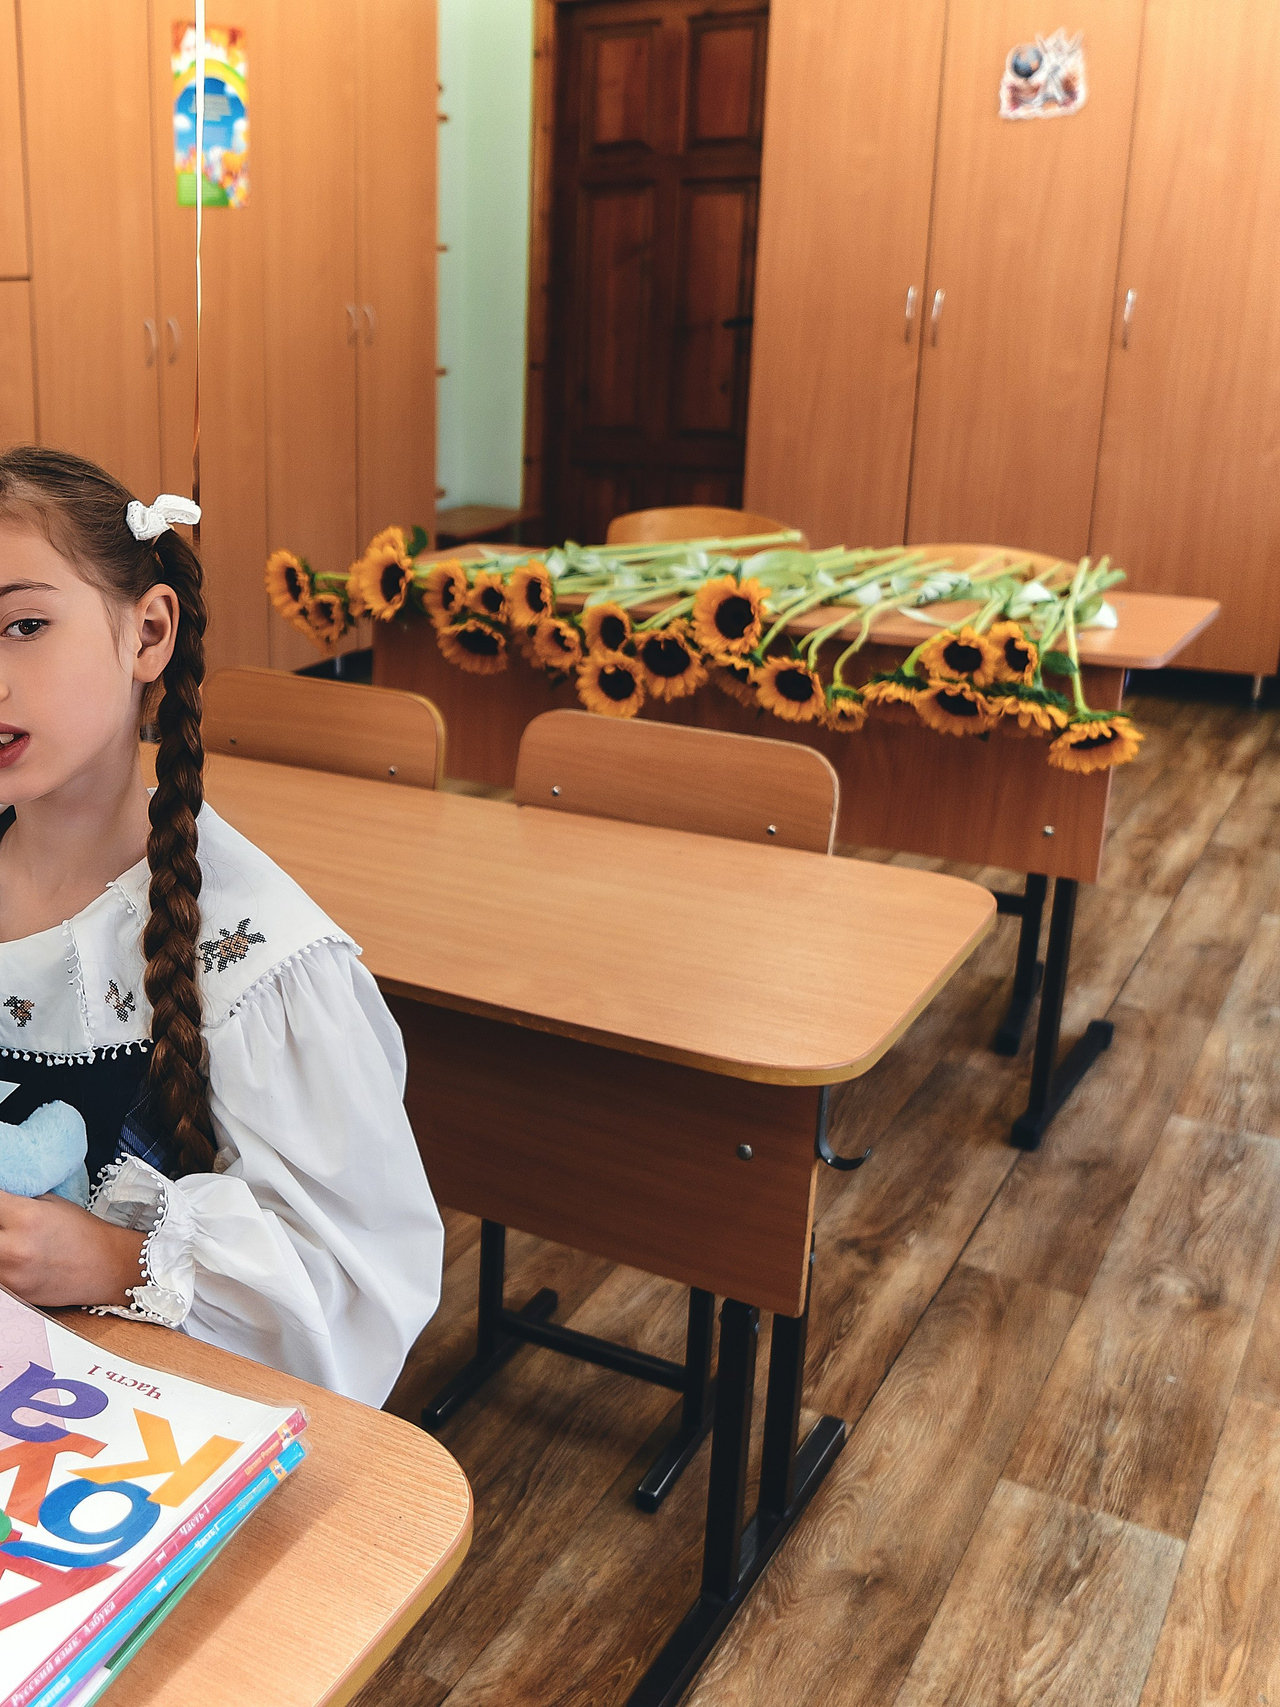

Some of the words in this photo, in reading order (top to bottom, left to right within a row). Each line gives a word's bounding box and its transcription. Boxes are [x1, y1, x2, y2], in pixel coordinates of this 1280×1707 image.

[86, 1364, 103, 1376] 1
[106, 1369, 162, 1400] Часть
[194, 1526, 217, 1549] Часть
[11, 1662, 54, 1707] Русский
[83, 1601, 116, 1636] Азбука
[179, 1510, 205, 1535] Часть
